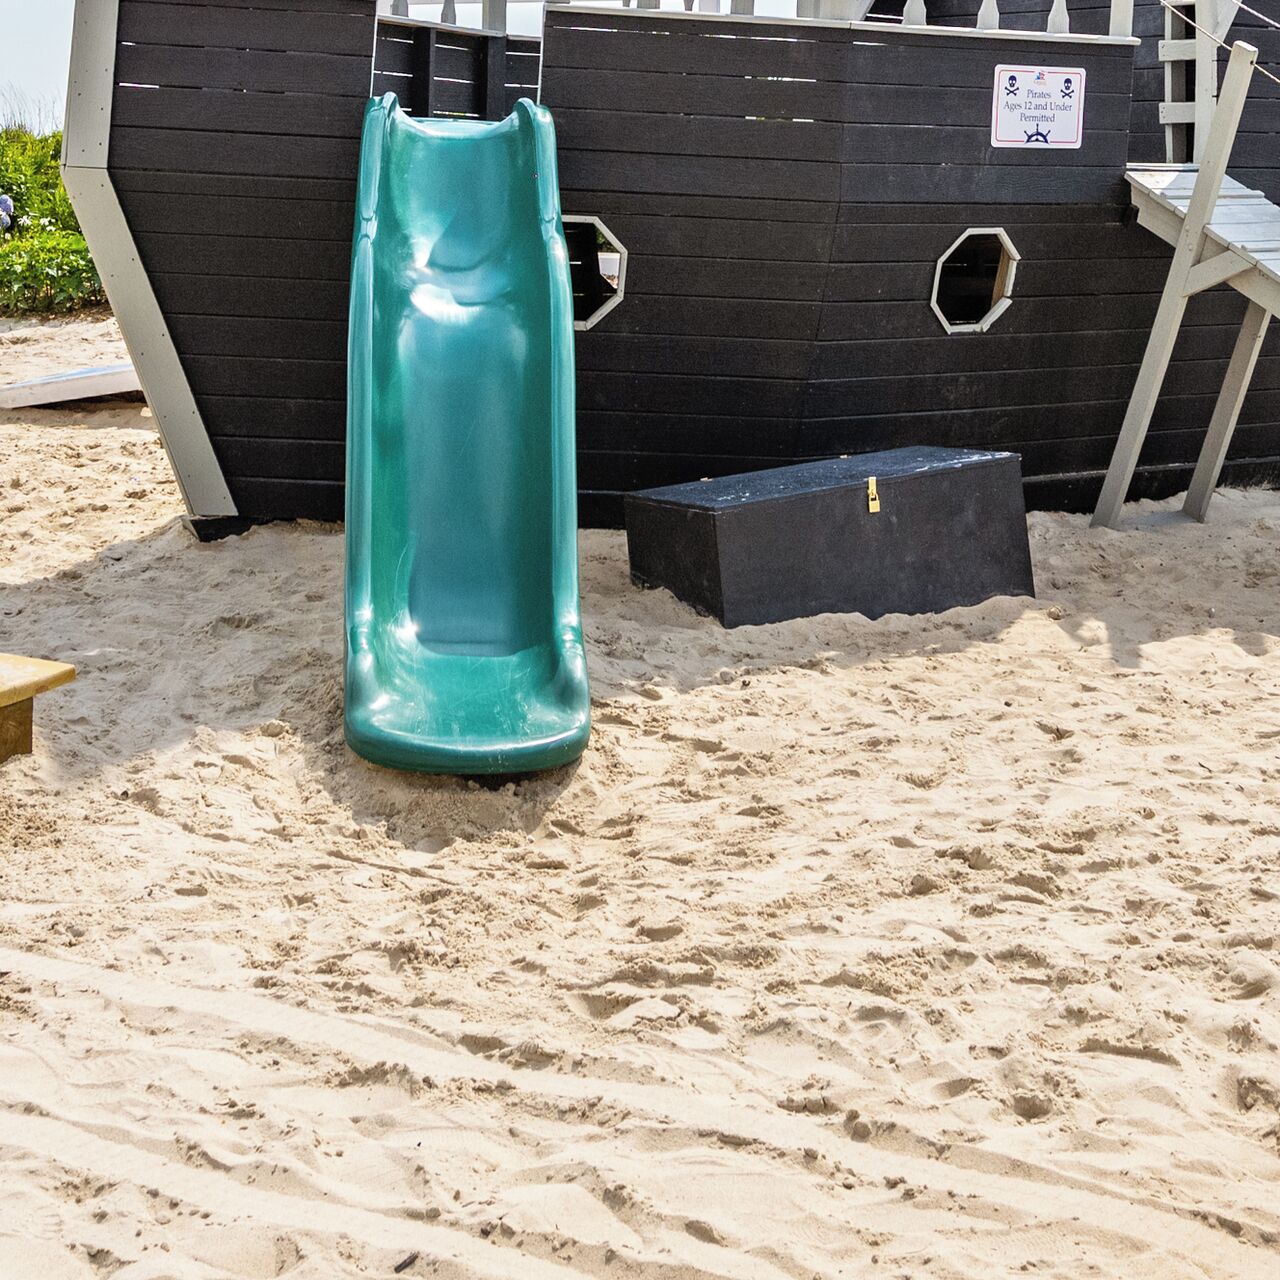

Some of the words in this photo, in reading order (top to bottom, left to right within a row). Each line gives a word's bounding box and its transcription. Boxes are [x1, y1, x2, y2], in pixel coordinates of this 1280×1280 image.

[1027, 89, 1051, 99] Pirates
[1003, 101, 1022, 112] Ages
[1024, 101, 1032, 110] 12
[1033, 102, 1048, 111] and
[1050, 102, 1072, 112] Under
[1020, 113, 1055, 123] Permitted
